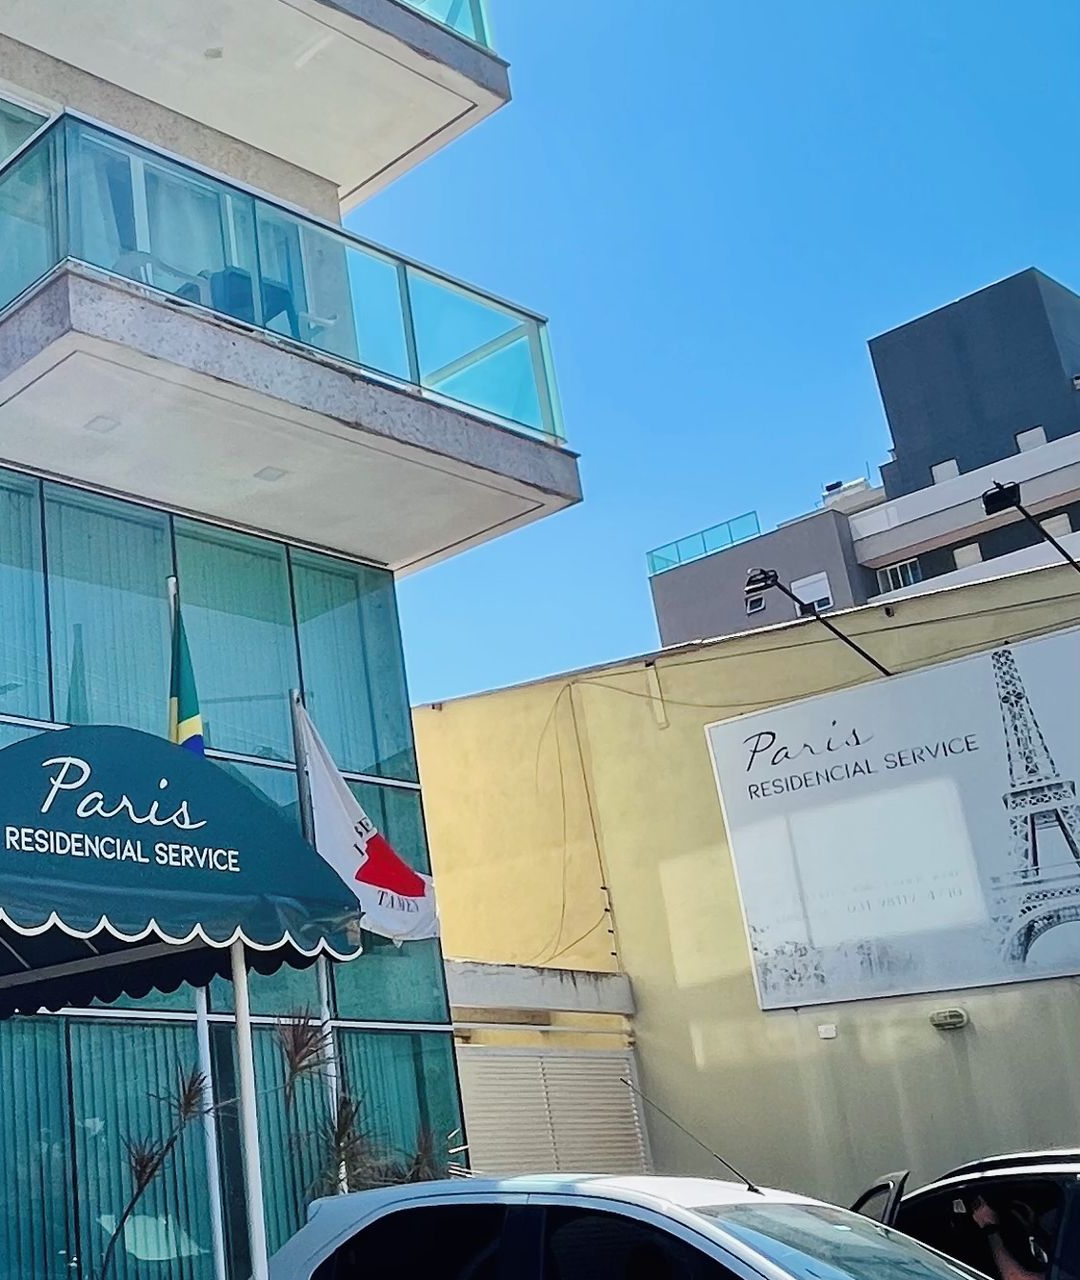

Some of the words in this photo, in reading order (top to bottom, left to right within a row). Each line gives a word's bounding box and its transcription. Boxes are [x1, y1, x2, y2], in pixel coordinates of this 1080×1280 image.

[743, 719, 874, 772] Paris
[747, 758, 879, 800] RESIDENCIAL
[883, 733, 980, 770] SERVICE
[40, 755, 208, 830] Paris
[4, 825, 150, 863] RESIDENCIAL
[153, 841, 241, 872] SERVICE
